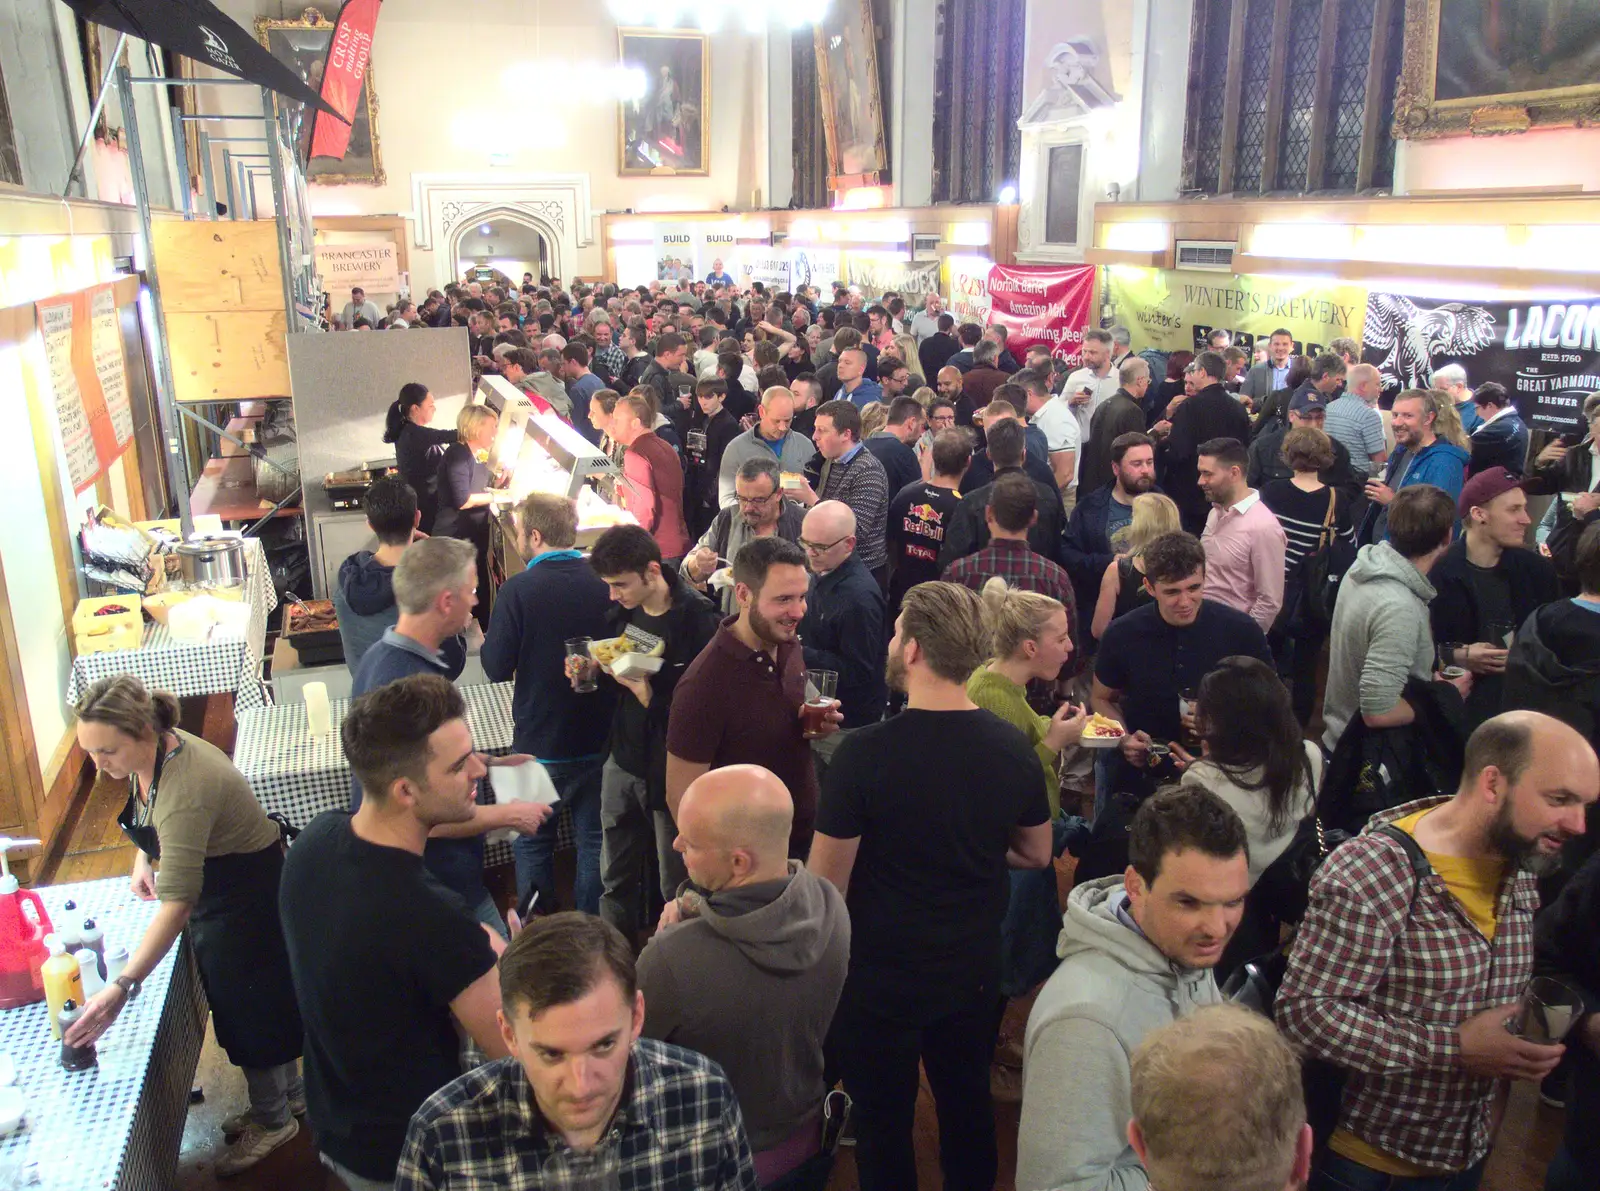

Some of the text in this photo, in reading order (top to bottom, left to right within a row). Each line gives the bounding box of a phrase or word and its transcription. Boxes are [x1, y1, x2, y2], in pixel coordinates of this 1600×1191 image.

[333, 22, 351, 68] CRISP
[345, 29, 363, 73] malting
[354, 33, 371, 79] GROUP
[663, 235, 691, 243] BUILD
[706, 235, 733, 243] BUILD
[321, 248, 392, 261] BRANCASTER
[332, 261, 382, 273] BREWERY
[989, 276, 1048, 298] Norfolk Barley
[1010, 300, 1067, 319] Amazing Malt
[1184, 284, 1356, 328] WINTER'S BREWERY
[1136, 305, 1181, 329] winter's
[1020, 323, 1060, 344] Stunning
[1561, 354, 1581, 363] 1760
[1516, 375, 1600, 392] GREAT YARMOUTH
[1538, 395, 1578, 407] BREWER
[906, 544, 934, 560] TOTAL
